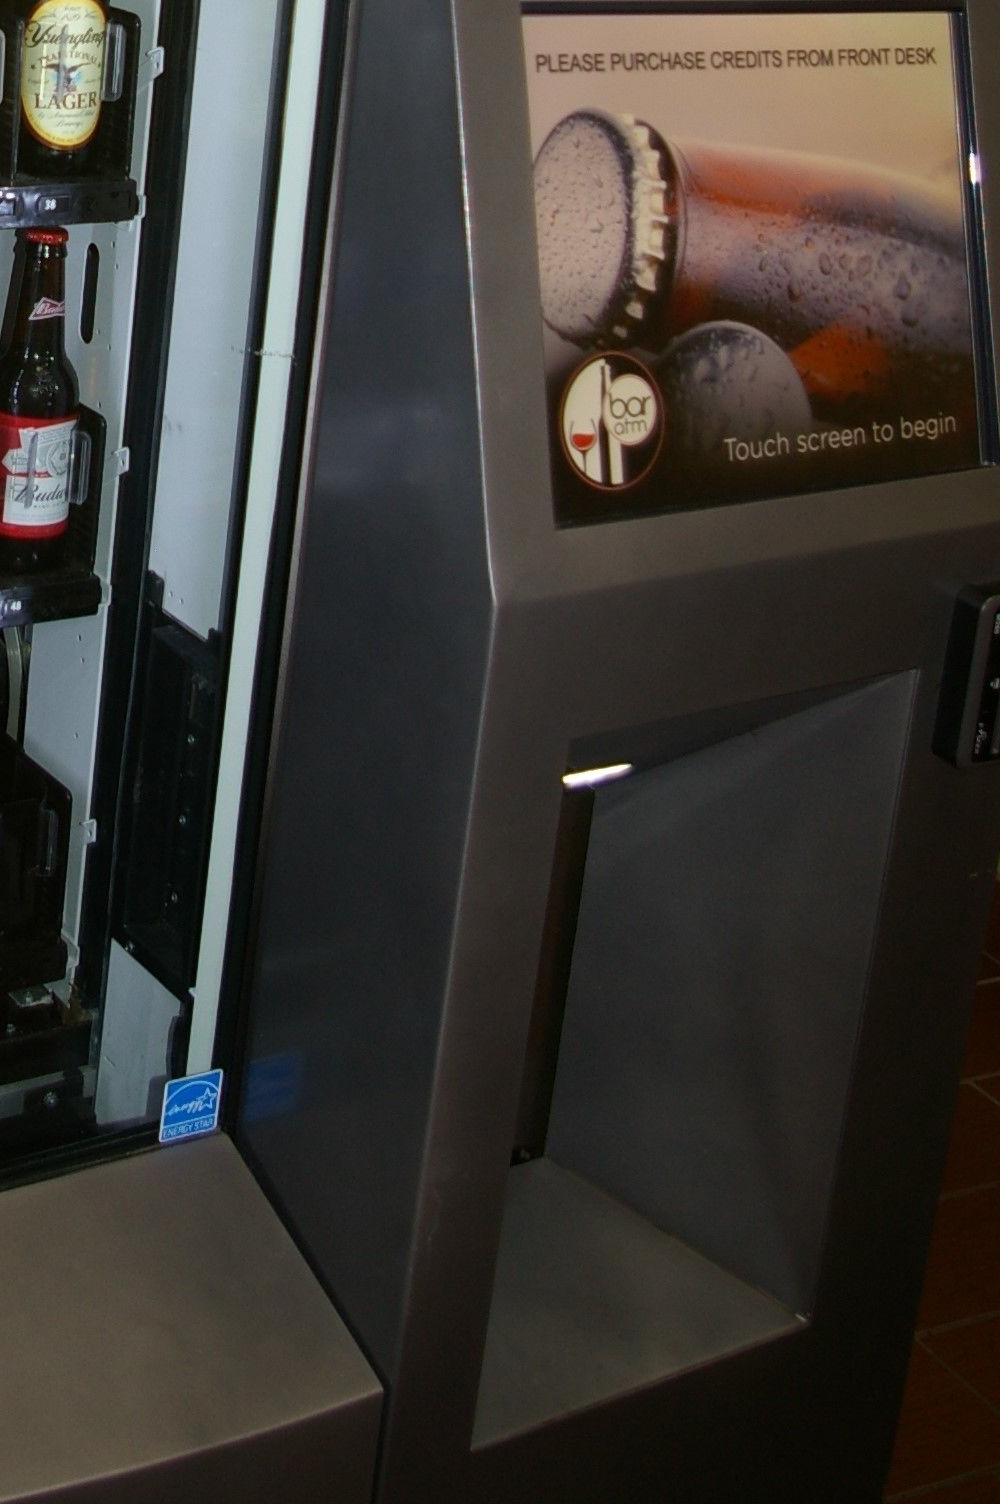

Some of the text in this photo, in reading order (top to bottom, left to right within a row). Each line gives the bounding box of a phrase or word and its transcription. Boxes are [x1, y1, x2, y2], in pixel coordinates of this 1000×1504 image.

[535, 47, 937, 73] PLEASE PURCHASE CREDITS FROM FRONT DESK
[34, 91, 98, 111] LAGER
[44, 198, 57, 211] 38
[607, 392, 651, 420] bar
[614, 418, 649, 436] atm
[723, 411, 957, 462] Touch screen to begin
[10, 600, 22, 611] 48
